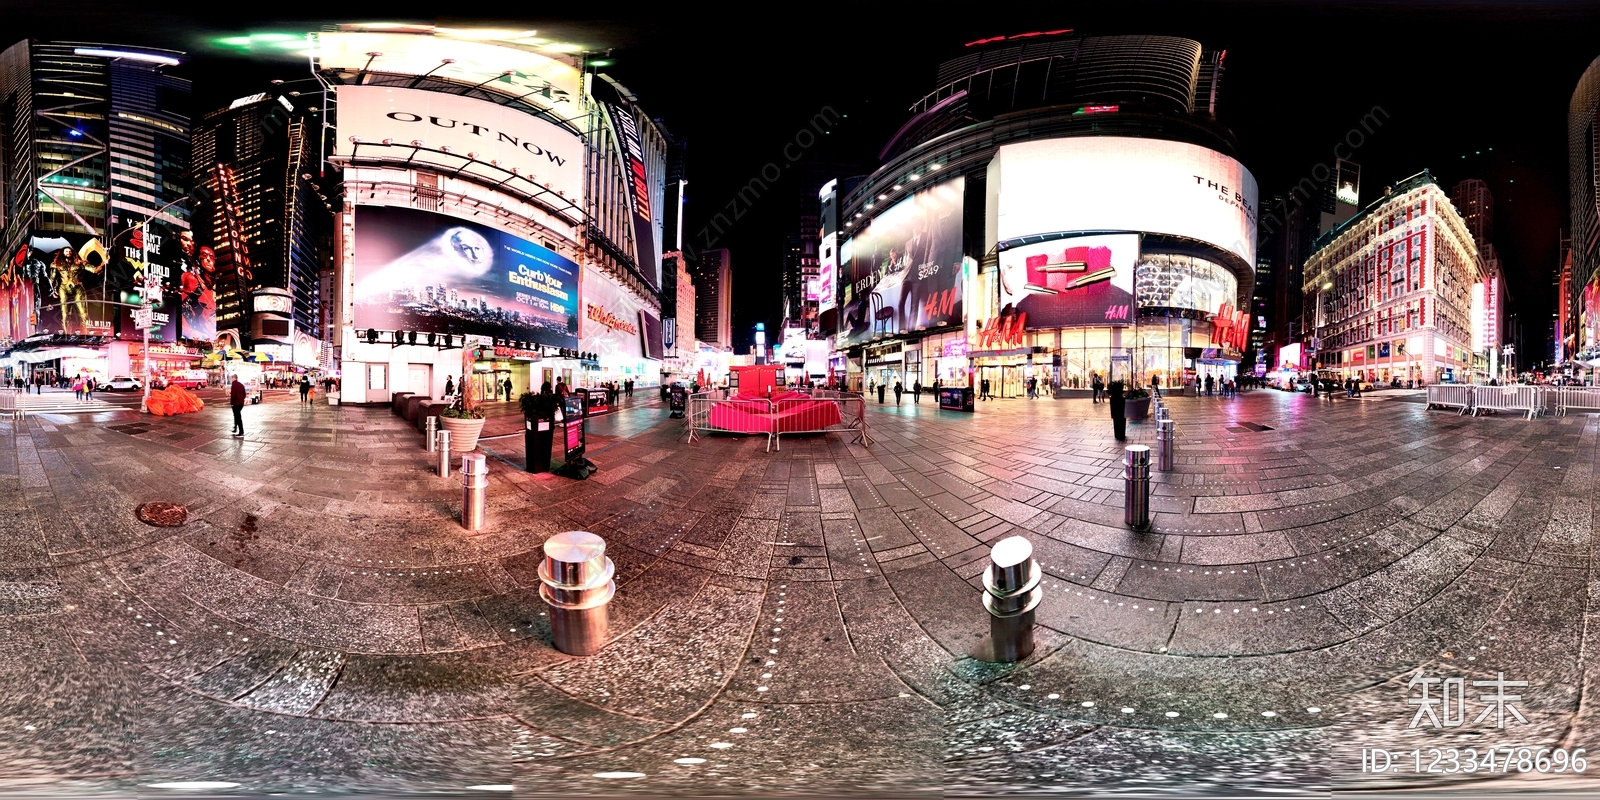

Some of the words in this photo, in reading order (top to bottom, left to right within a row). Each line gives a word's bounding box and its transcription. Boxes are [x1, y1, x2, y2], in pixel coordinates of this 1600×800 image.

[386, 111, 489, 136] OUT
[496, 131, 566, 168] NOW
[634, 176, 650, 222] GOTTI
[1193, 175, 1228, 196] THE
[229, 218, 244, 276] YOUNG
[511, 248, 525, 256] WORLD
[508, 271, 569, 301] Enthusiasm
[518, 264, 544, 282] Curb
[543, 272, 563, 289] Your
[918, 265, 939, 281] $249
[152, 311, 169, 323] LEAGUE
[515, 296, 529, 305] OCT
[550, 301, 565, 314] HBO
[923, 287, 957, 320] H&M
[1105, 305, 1128, 321] H&M
[979, 312, 1027, 348] H&M
[1211, 302, 1251, 353] H&M
